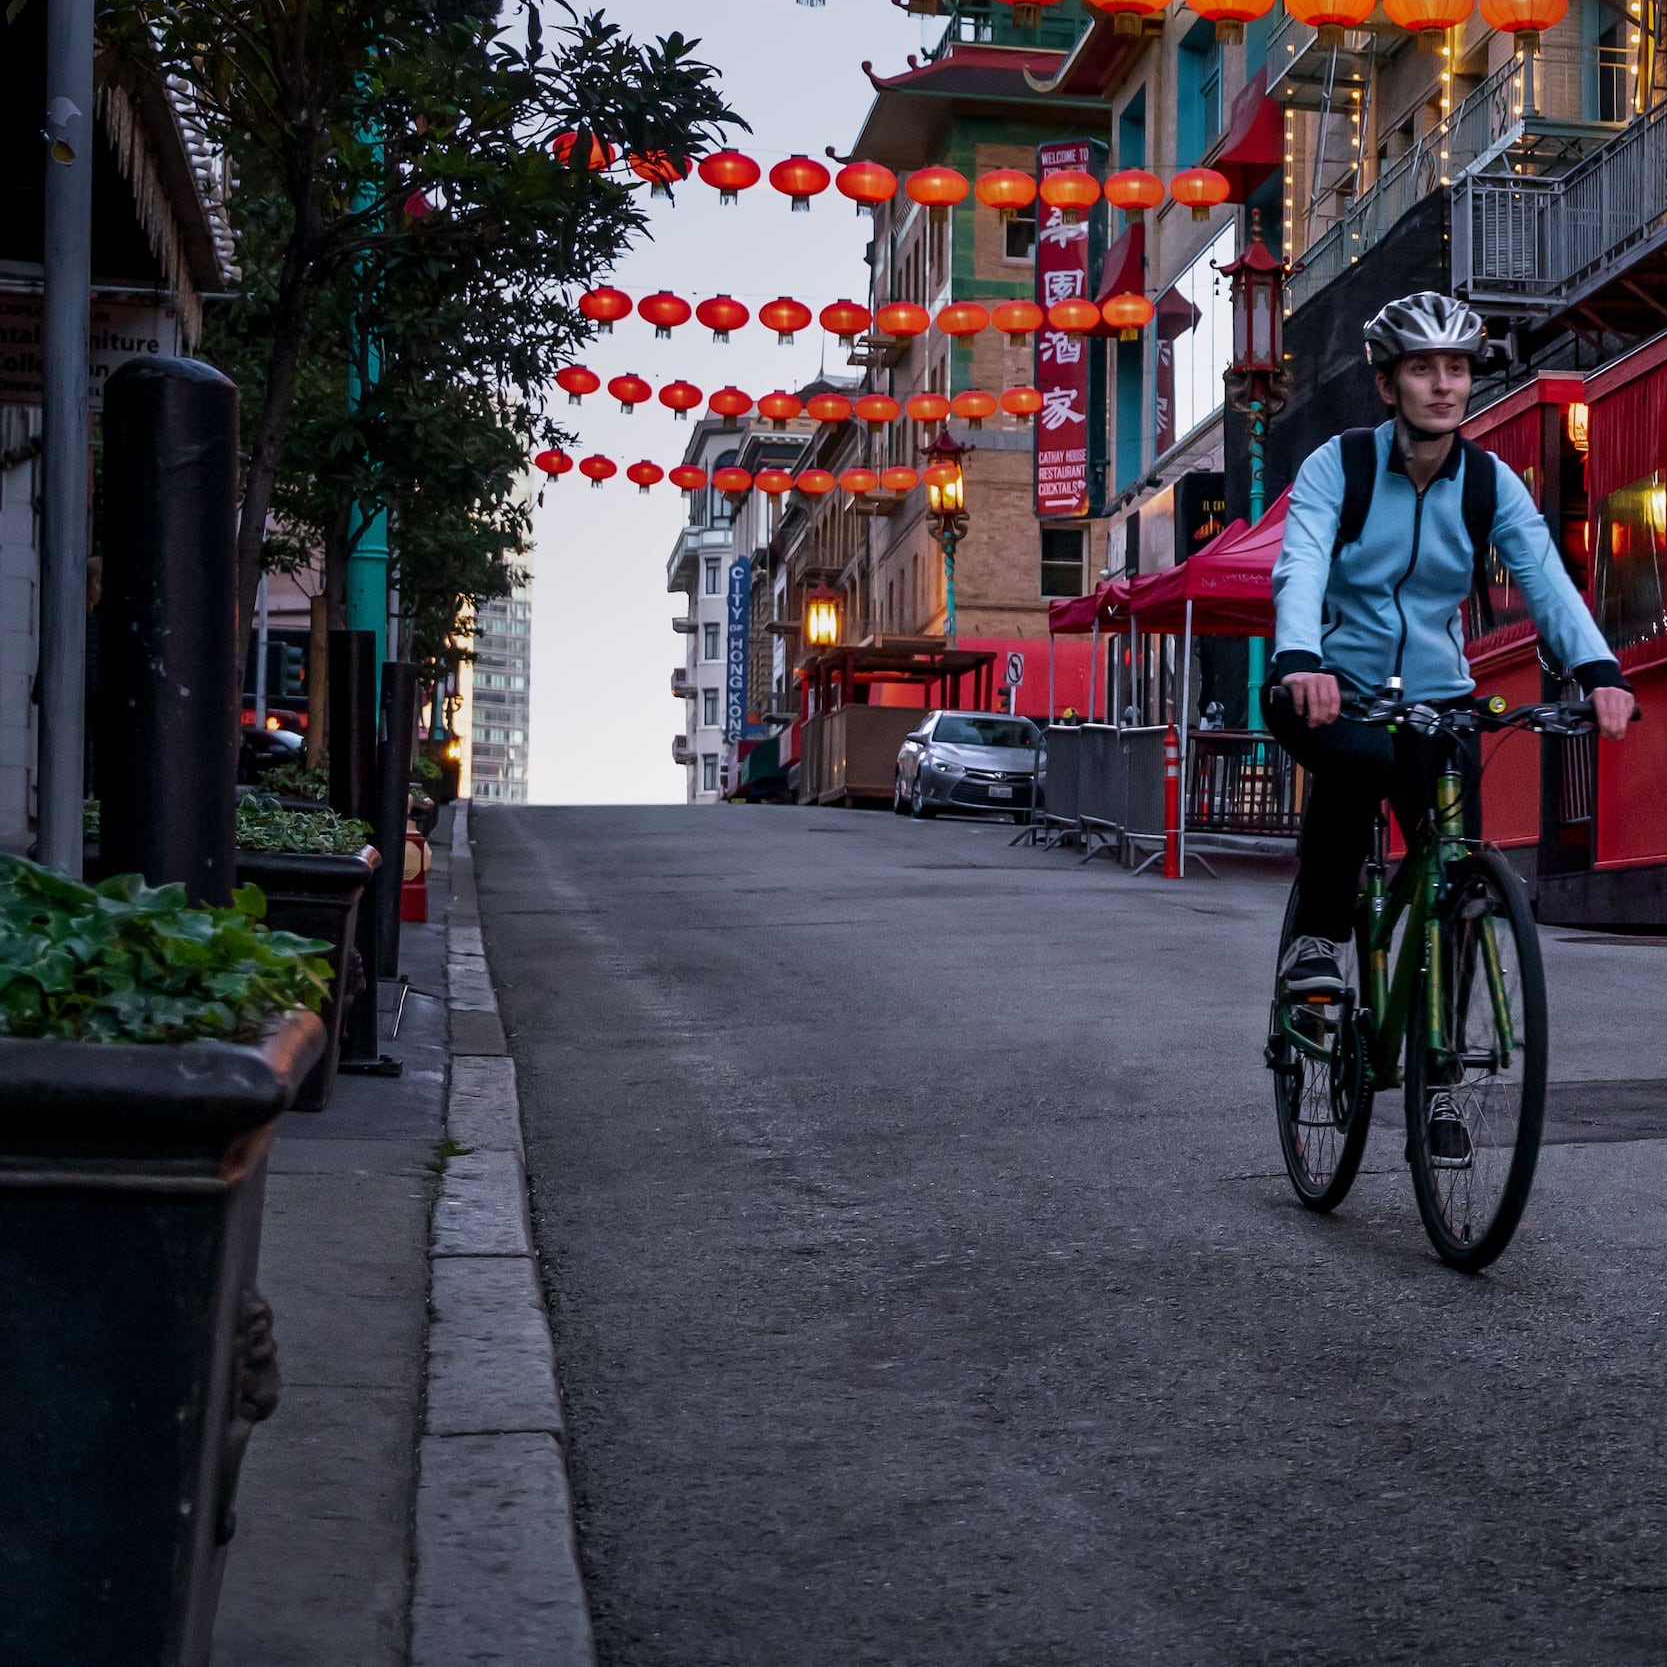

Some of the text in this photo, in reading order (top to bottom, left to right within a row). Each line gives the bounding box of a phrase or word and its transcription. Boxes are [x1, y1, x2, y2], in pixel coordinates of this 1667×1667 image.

[1041, 148, 1089, 165] WELCOME TO
[1039, 464, 1086, 480] RESTAURANT
[1039, 481, 1078, 495] COCKTAILS
[731, 566, 744, 620] CITY
[729, 624, 744, 632] OF
[729, 638, 744, 688] HONG
[728, 692, 743, 744] KONG
